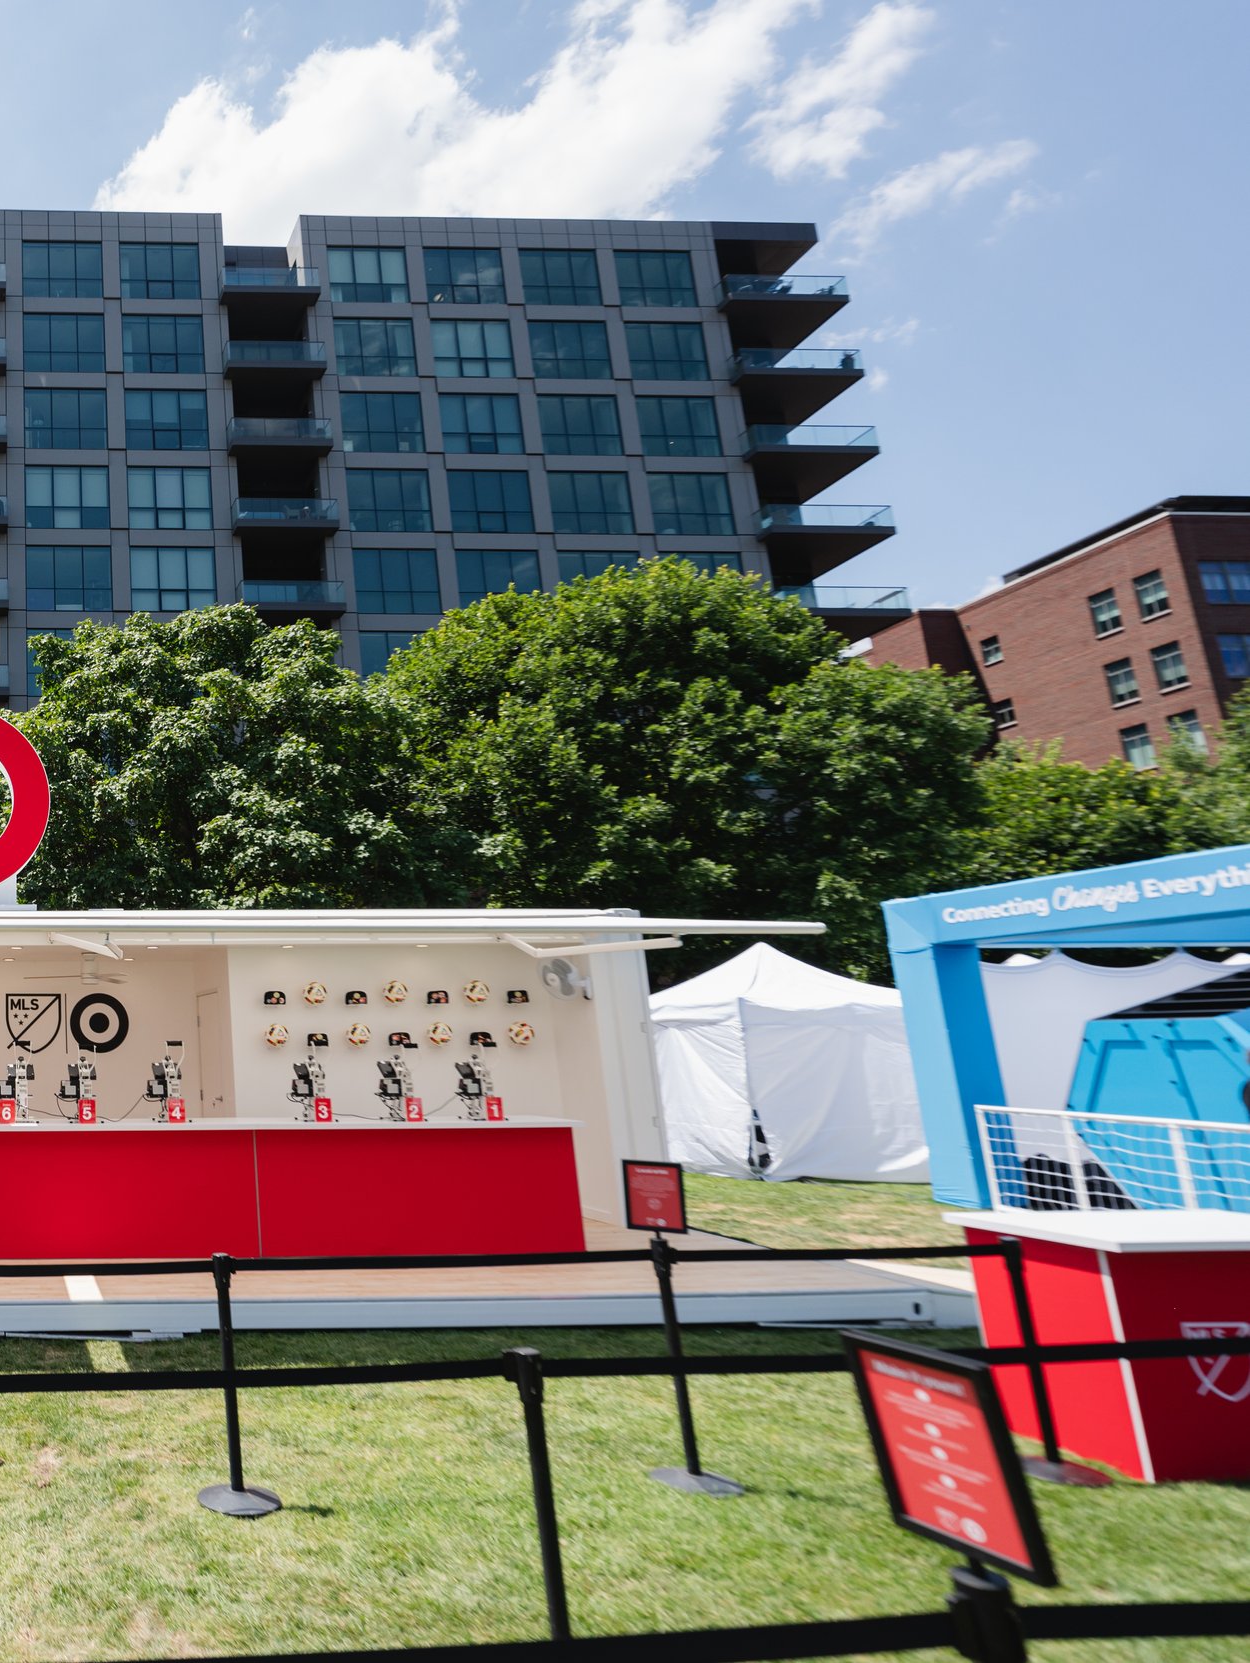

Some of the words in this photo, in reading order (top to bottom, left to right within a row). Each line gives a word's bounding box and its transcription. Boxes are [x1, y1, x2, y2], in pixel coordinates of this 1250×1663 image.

[942, 897, 1050, 924] Connecting
[10, 999, 39, 1011] MLS
[1, 1106, 12, 1121] 6
[82, 1106, 93, 1121] 5
[171, 1105, 182, 1120] 4
[317, 1104, 329, 1119] 3
[408, 1104, 420, 1119] 2
[490, 1104, 500, 1118] 1
